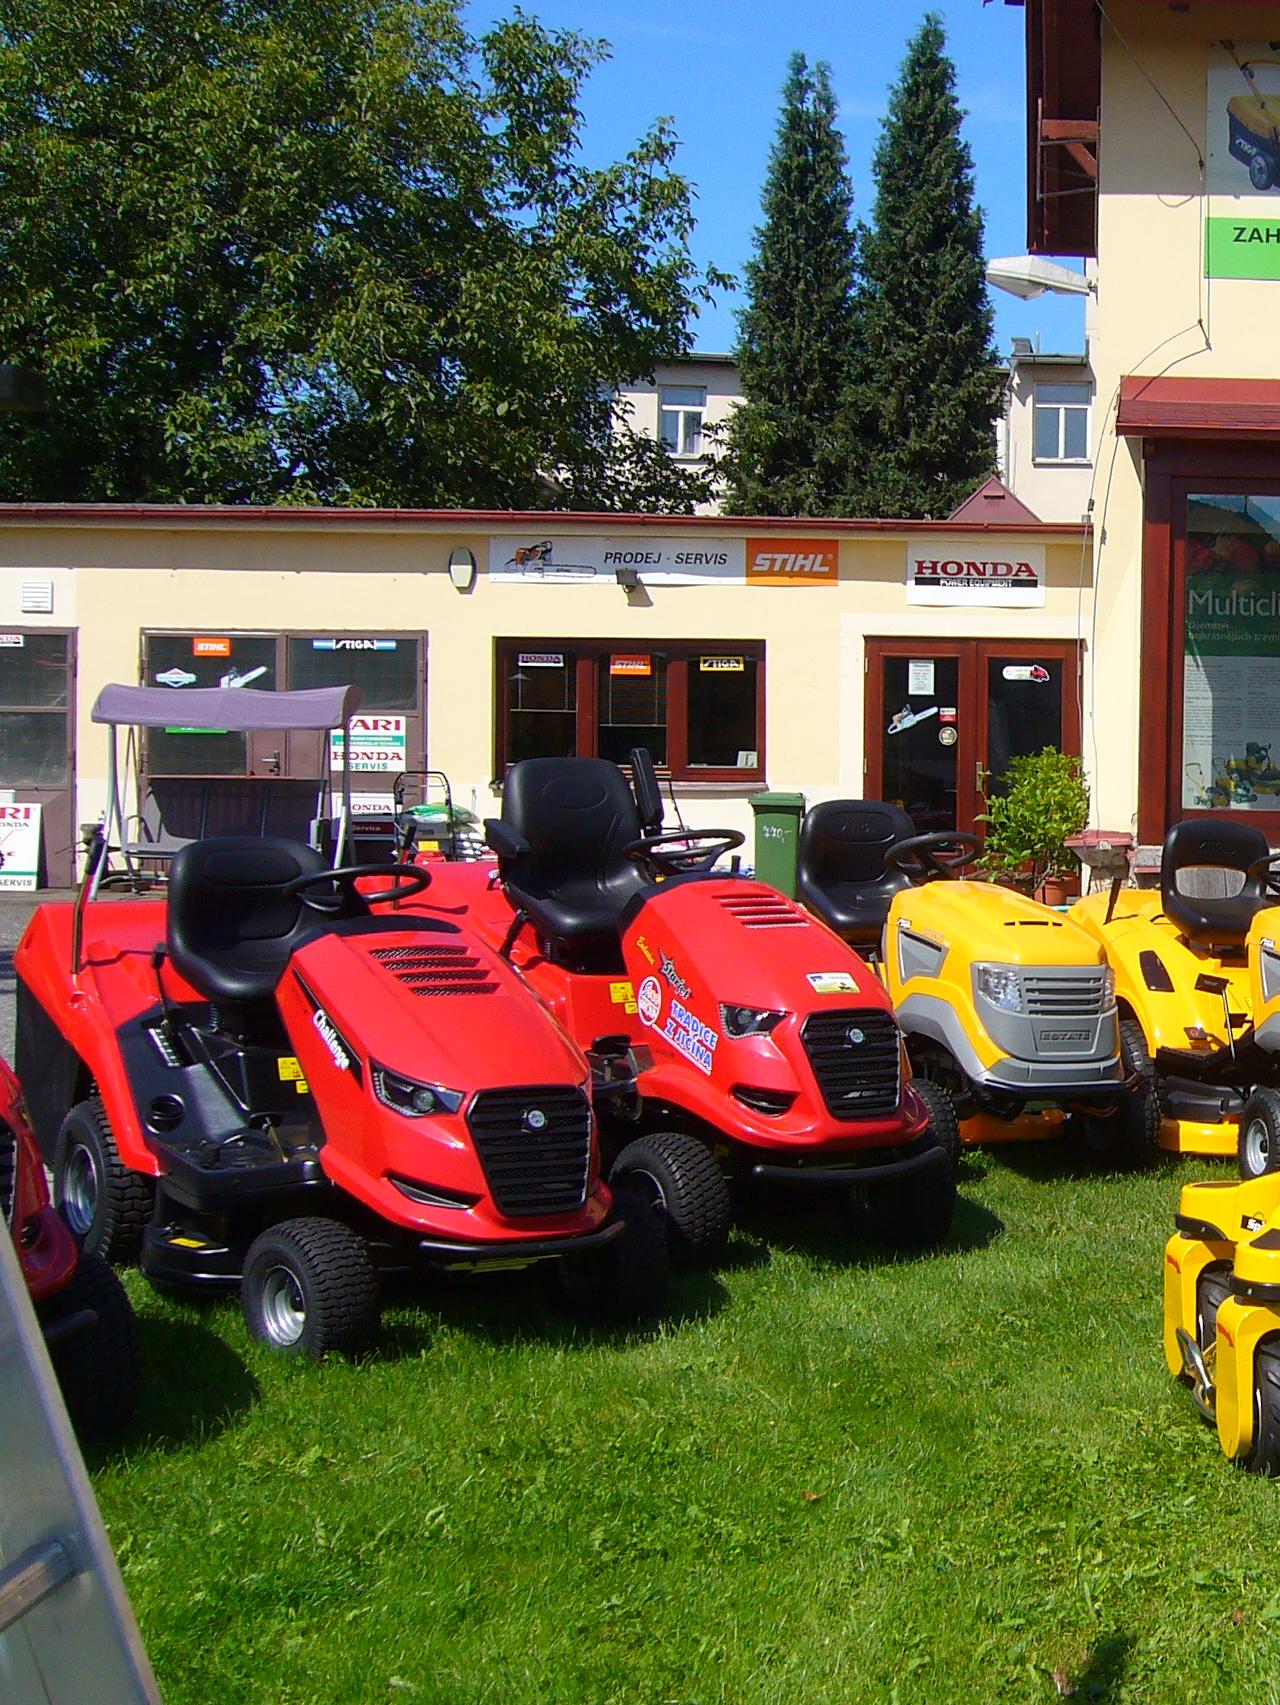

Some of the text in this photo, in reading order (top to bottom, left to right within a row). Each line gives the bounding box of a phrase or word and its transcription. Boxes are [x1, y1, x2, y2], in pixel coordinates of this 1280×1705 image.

[603, 552, 662, 565] PRODEJ
[674, 552, 728, 565] SERVIS
[914, 560, 1038, 578] HONDA
[335, 639, 374, 650] STIGA
[521, 655, 561, 663] HONDA
[351, 719, 401, 731] ARI
[352, 803, 392, 812] ONDA
[672, 1001, 717, 1049] TRADICE
[313, 1009, 350, 1070] Challenge
